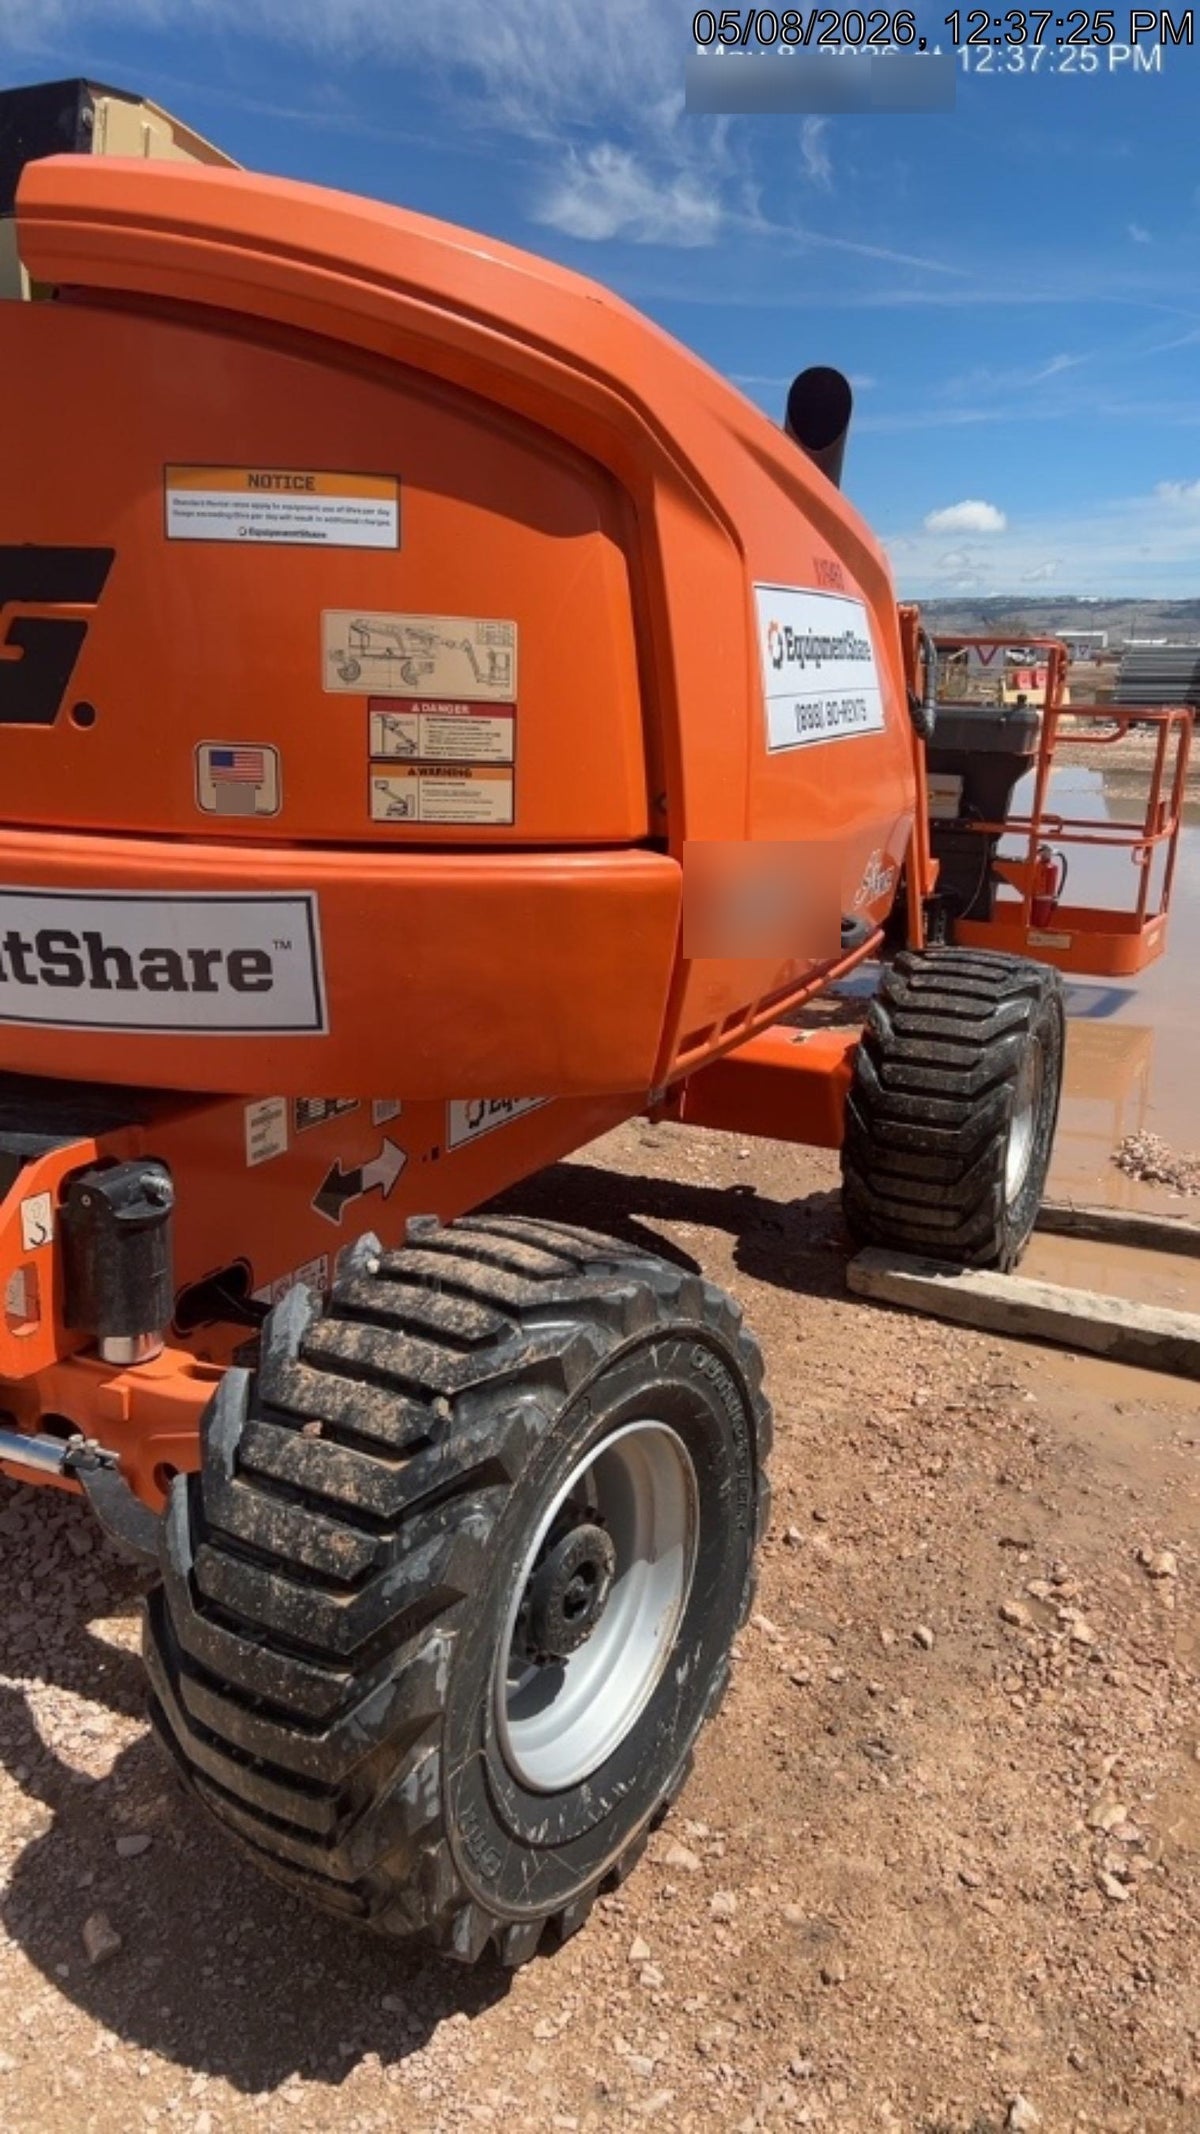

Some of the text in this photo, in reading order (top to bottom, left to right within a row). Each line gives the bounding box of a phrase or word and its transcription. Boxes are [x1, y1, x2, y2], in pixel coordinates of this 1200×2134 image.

[248, 473, 316, 491] NOTICE
[421, 703, 470, 715] DANGER
[418, 767, 473, 779] WARNING
[0, 928, 274, 992] tShare
